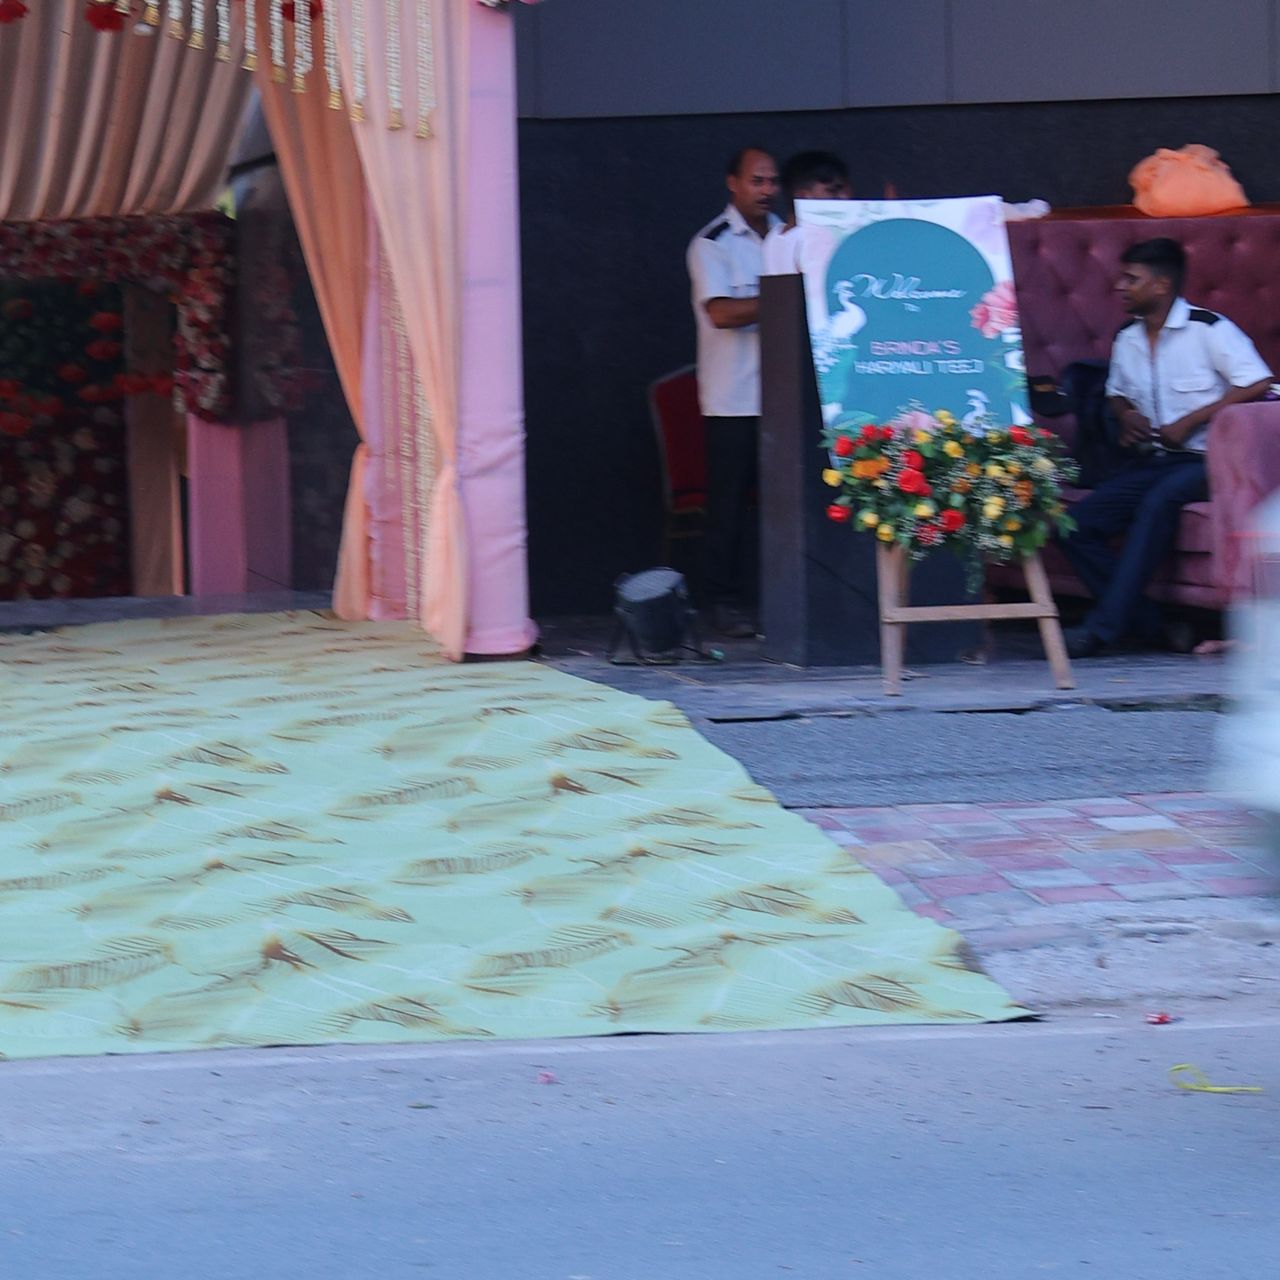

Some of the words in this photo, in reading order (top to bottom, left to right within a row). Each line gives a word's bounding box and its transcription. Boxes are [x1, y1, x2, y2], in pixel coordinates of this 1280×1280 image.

[849, 272, 967, 299] Welcome
[870, 340, 961, 355] BRINDA'S
[933, 359, 984, 375] TEEJ
